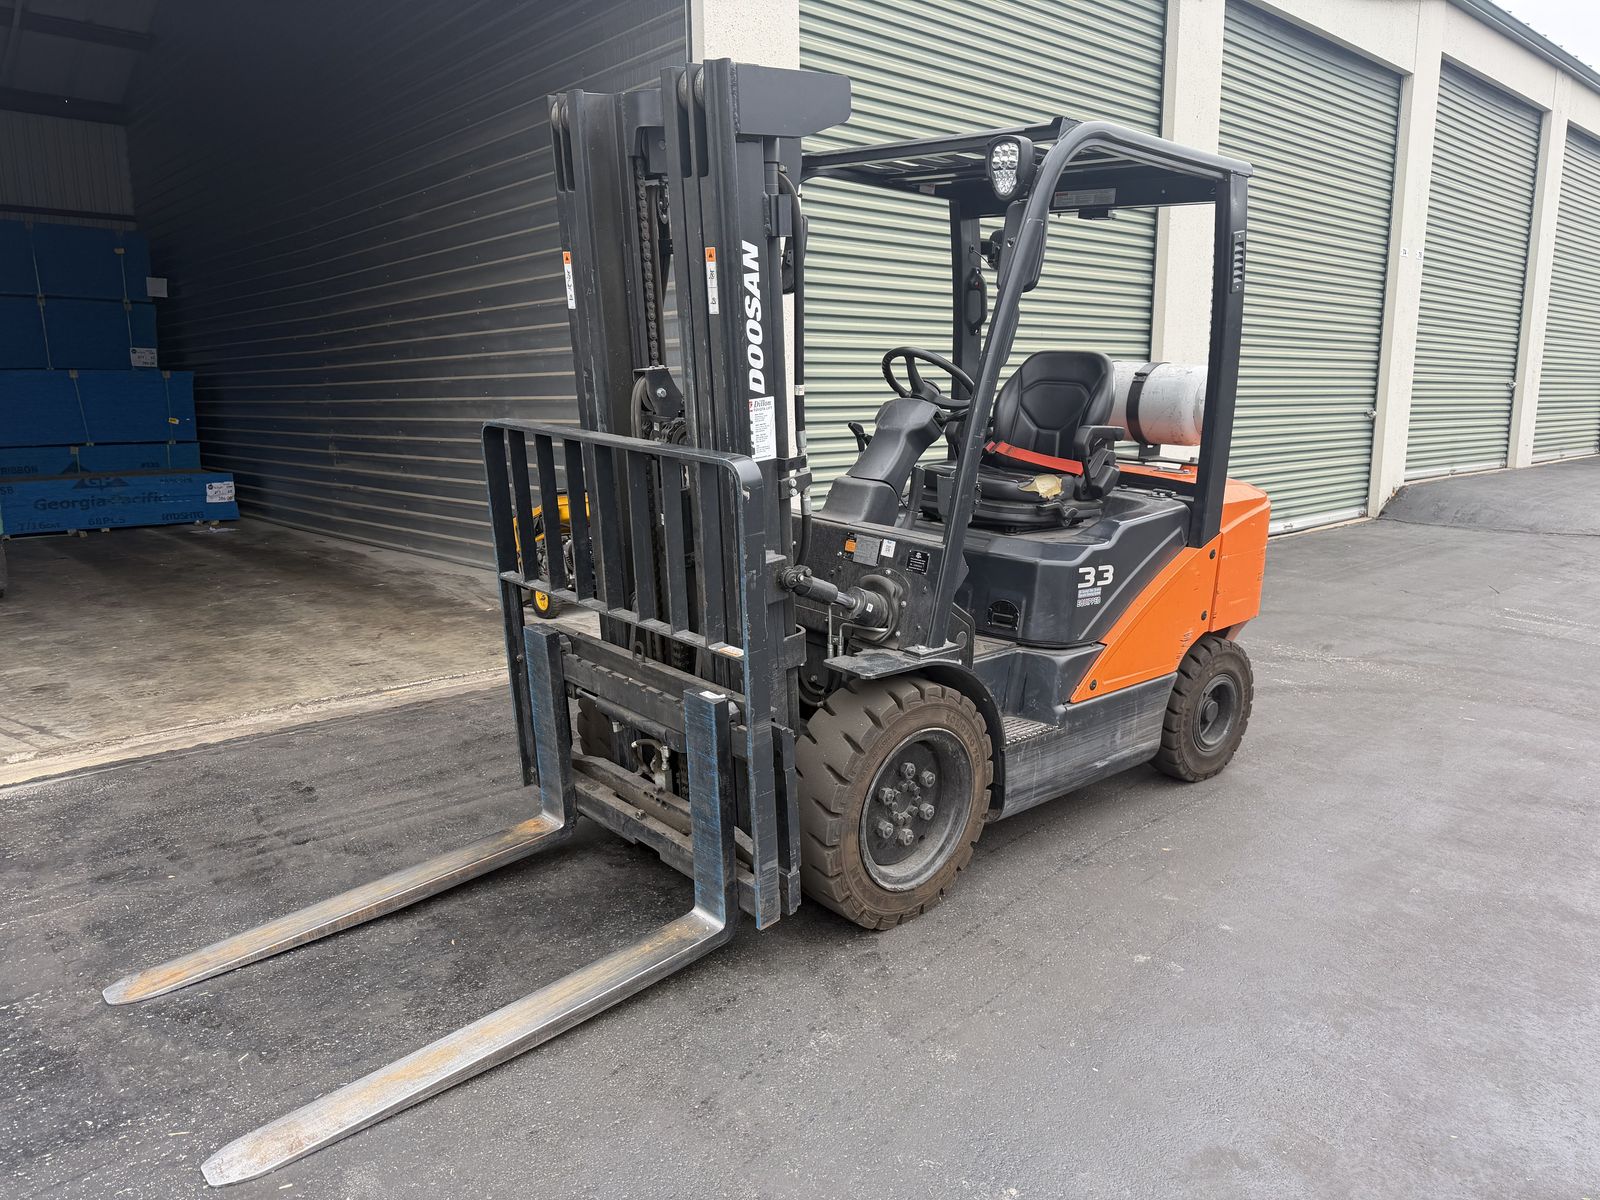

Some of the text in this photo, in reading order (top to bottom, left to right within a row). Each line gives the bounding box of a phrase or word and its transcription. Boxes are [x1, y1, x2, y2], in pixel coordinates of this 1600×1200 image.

[741, 240, 766, 394] DOOSAN
[33, 491, 168, 511] Georgia-Pacific
[1077, 564, 1115, 589] 33
[1076, 596, 1102, 608] EQUIPPED
